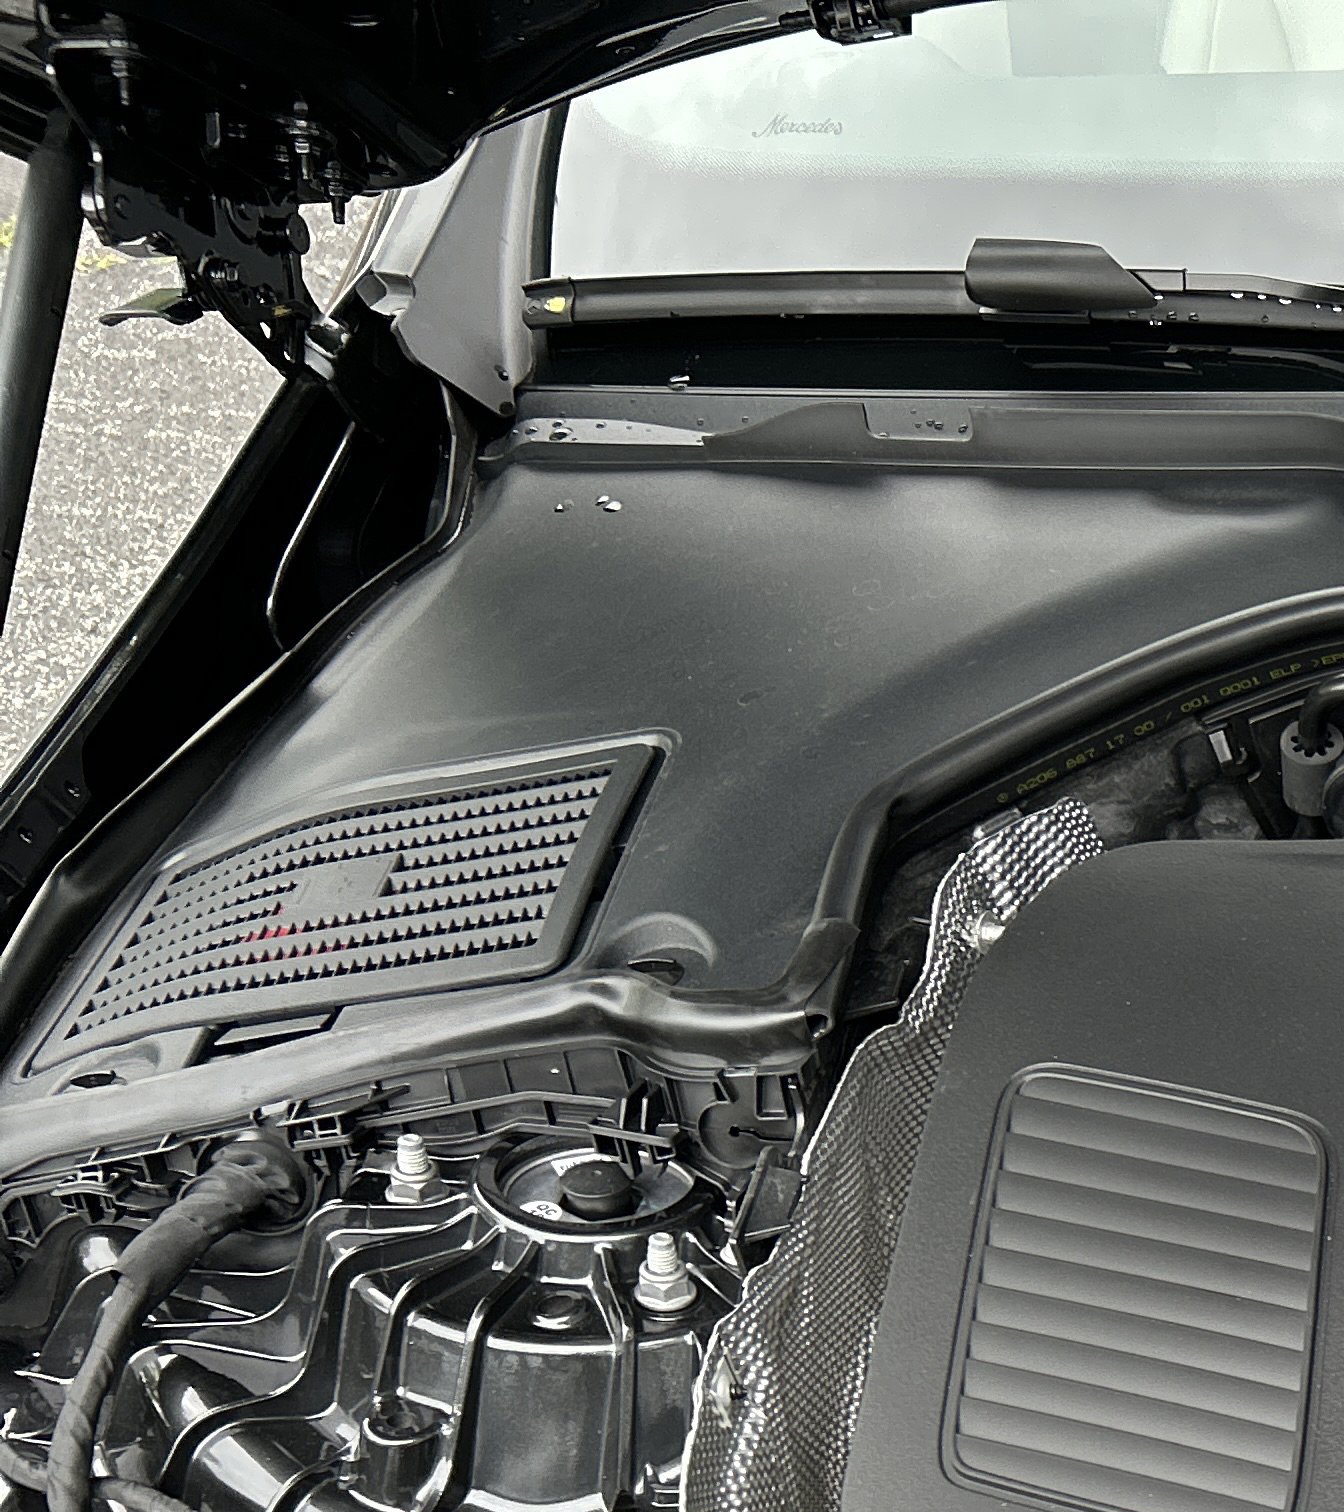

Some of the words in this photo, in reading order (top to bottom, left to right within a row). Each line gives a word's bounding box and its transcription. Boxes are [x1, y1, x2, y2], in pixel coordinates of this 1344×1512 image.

[751, 114, 843, 138] Mercedes
[1017, 769, 1057, 795] A206
[1105, 734, 1125, 750] 17
[1134, 720, 1155, 736] 00
[1180, 695, 1210, 713] 001
[1269, 663, 1302, 680] ELP
